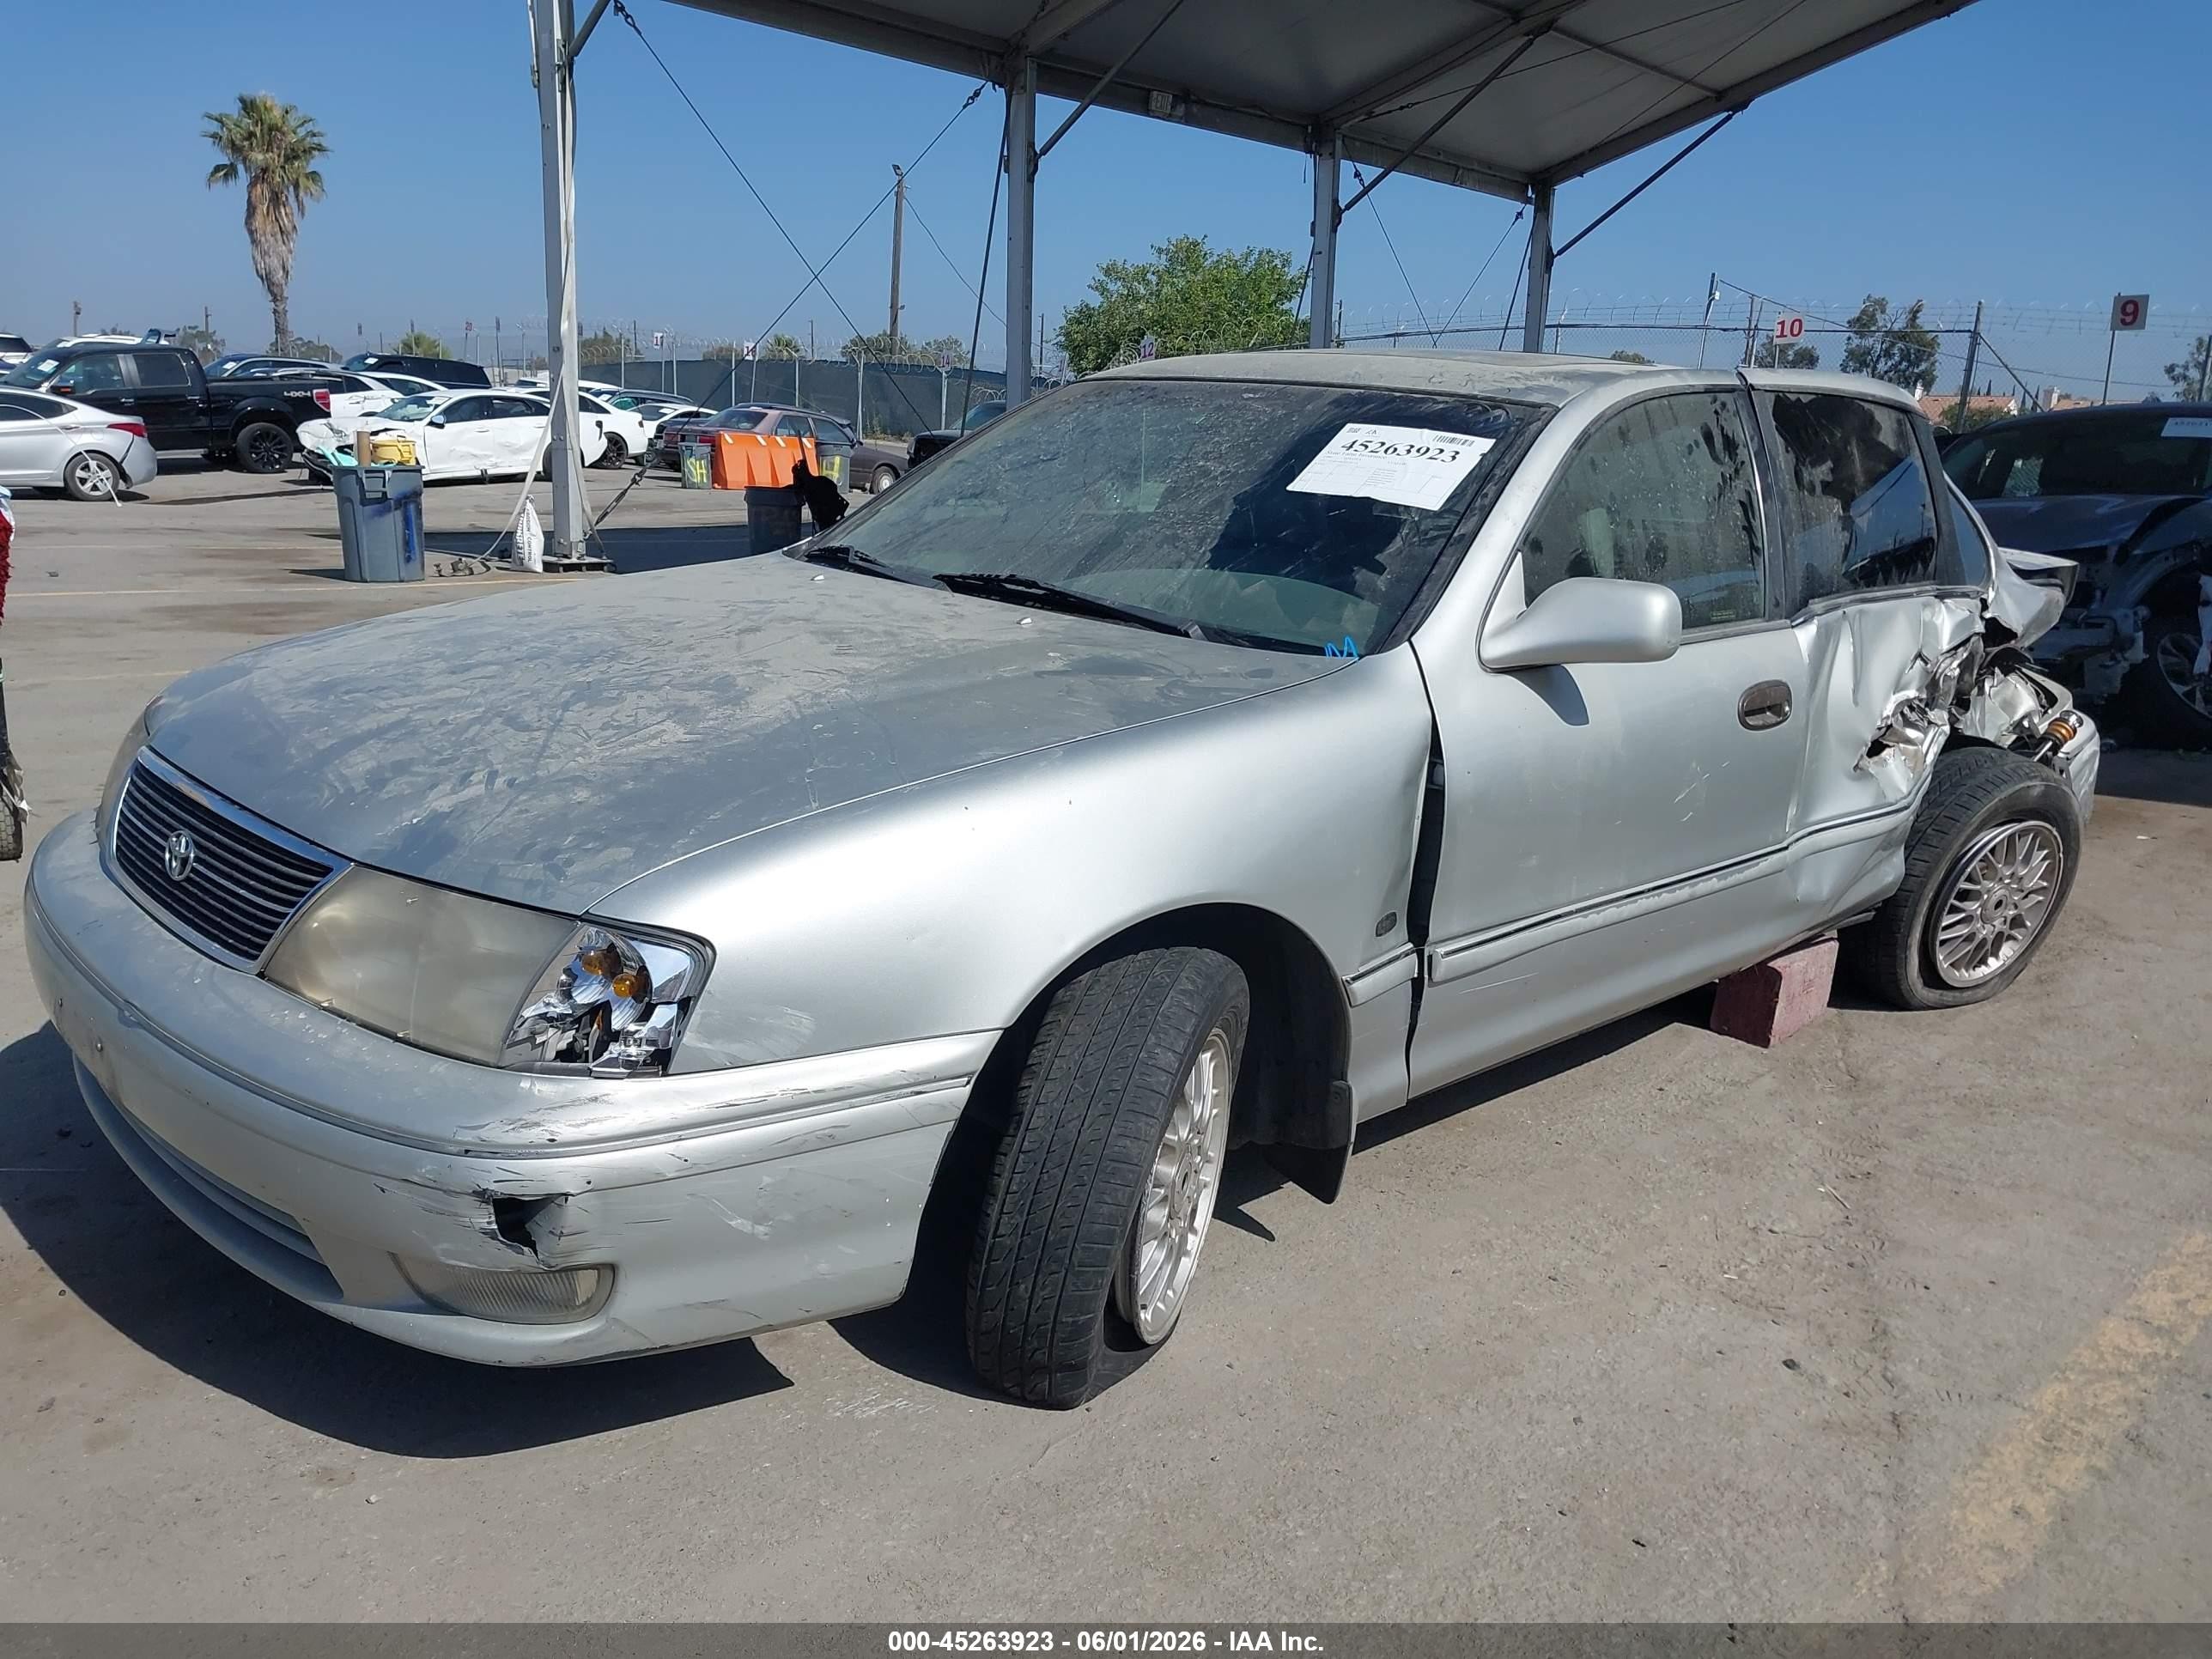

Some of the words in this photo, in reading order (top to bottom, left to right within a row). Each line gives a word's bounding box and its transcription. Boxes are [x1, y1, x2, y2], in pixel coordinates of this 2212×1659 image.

[2120, 299, 2139, 326] 9
[1775, 318, 1803, 338] 10
[1141, 342, 1154, 359] 12
[1341, 439, 1462, 463] 45263923
